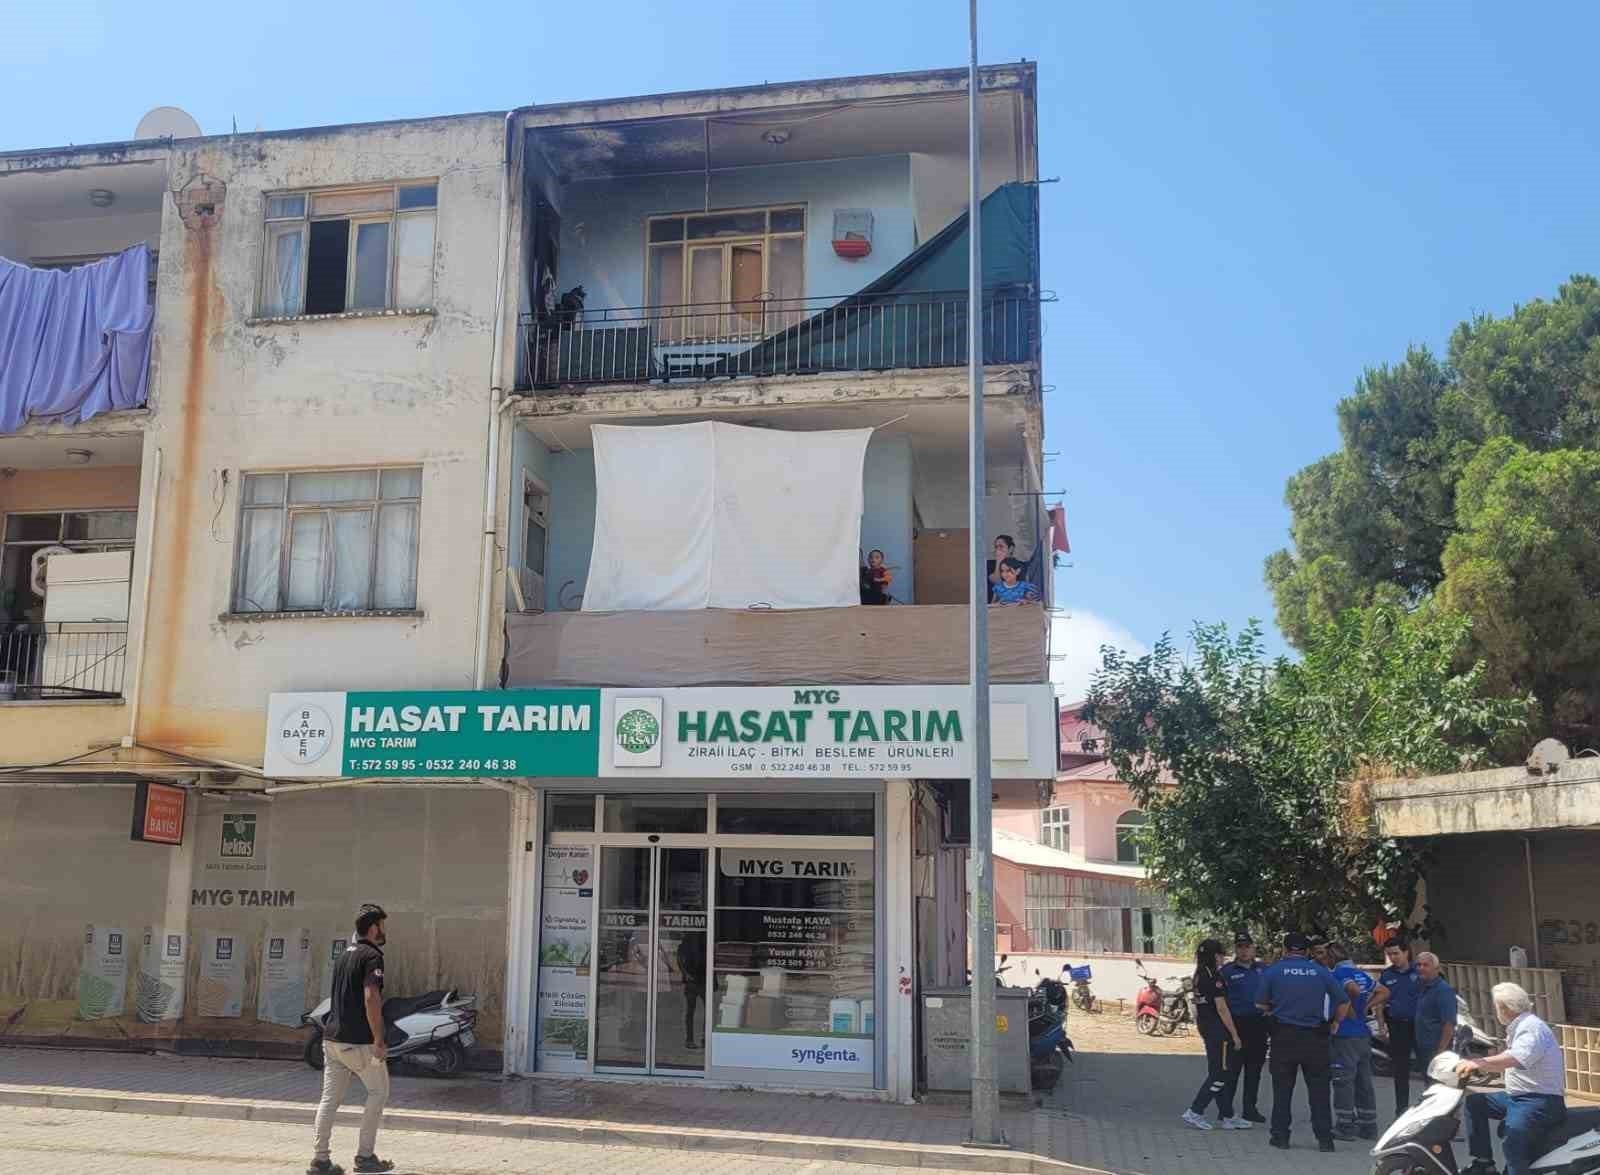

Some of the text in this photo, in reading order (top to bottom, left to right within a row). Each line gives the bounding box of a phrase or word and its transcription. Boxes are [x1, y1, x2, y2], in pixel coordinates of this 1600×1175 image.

[793, 690, 841, 705] MYG
[350, 704, 592, 733] HASAT TARIM
[677, 709, 963, 743] HASAT TARIM
[283, 729, 326, 738] BAYER
[350, 738, 417, 749] MYG TARIM
[815, 747, 876, 758] BESLEME
[887, 746, 955, 758] ÜRÜNLERİ
[385, 759, 398, 770] 59
[402, 759, 416, 770] 95
[426, 759, 454, 770] 0532
[459, 759, 480, 770] 240
[484, 759, 499, 770] 46
[502, 759, 517, 770] 38
[730, 763, 753, 772] GSM
[869, 763, 885, 772] 572
[901, 763, 912, 772] 95
[739, 859, 784, 875] MYG
[191, 889, 295, 907] MYG TARIM
[607, 914, 706, 928] MYG TARIM
[804, 916, 831, 925] KAYA
[1283, 968, 1318, 976] POLİS
[792, 1048, 857, 1064] syngenta
